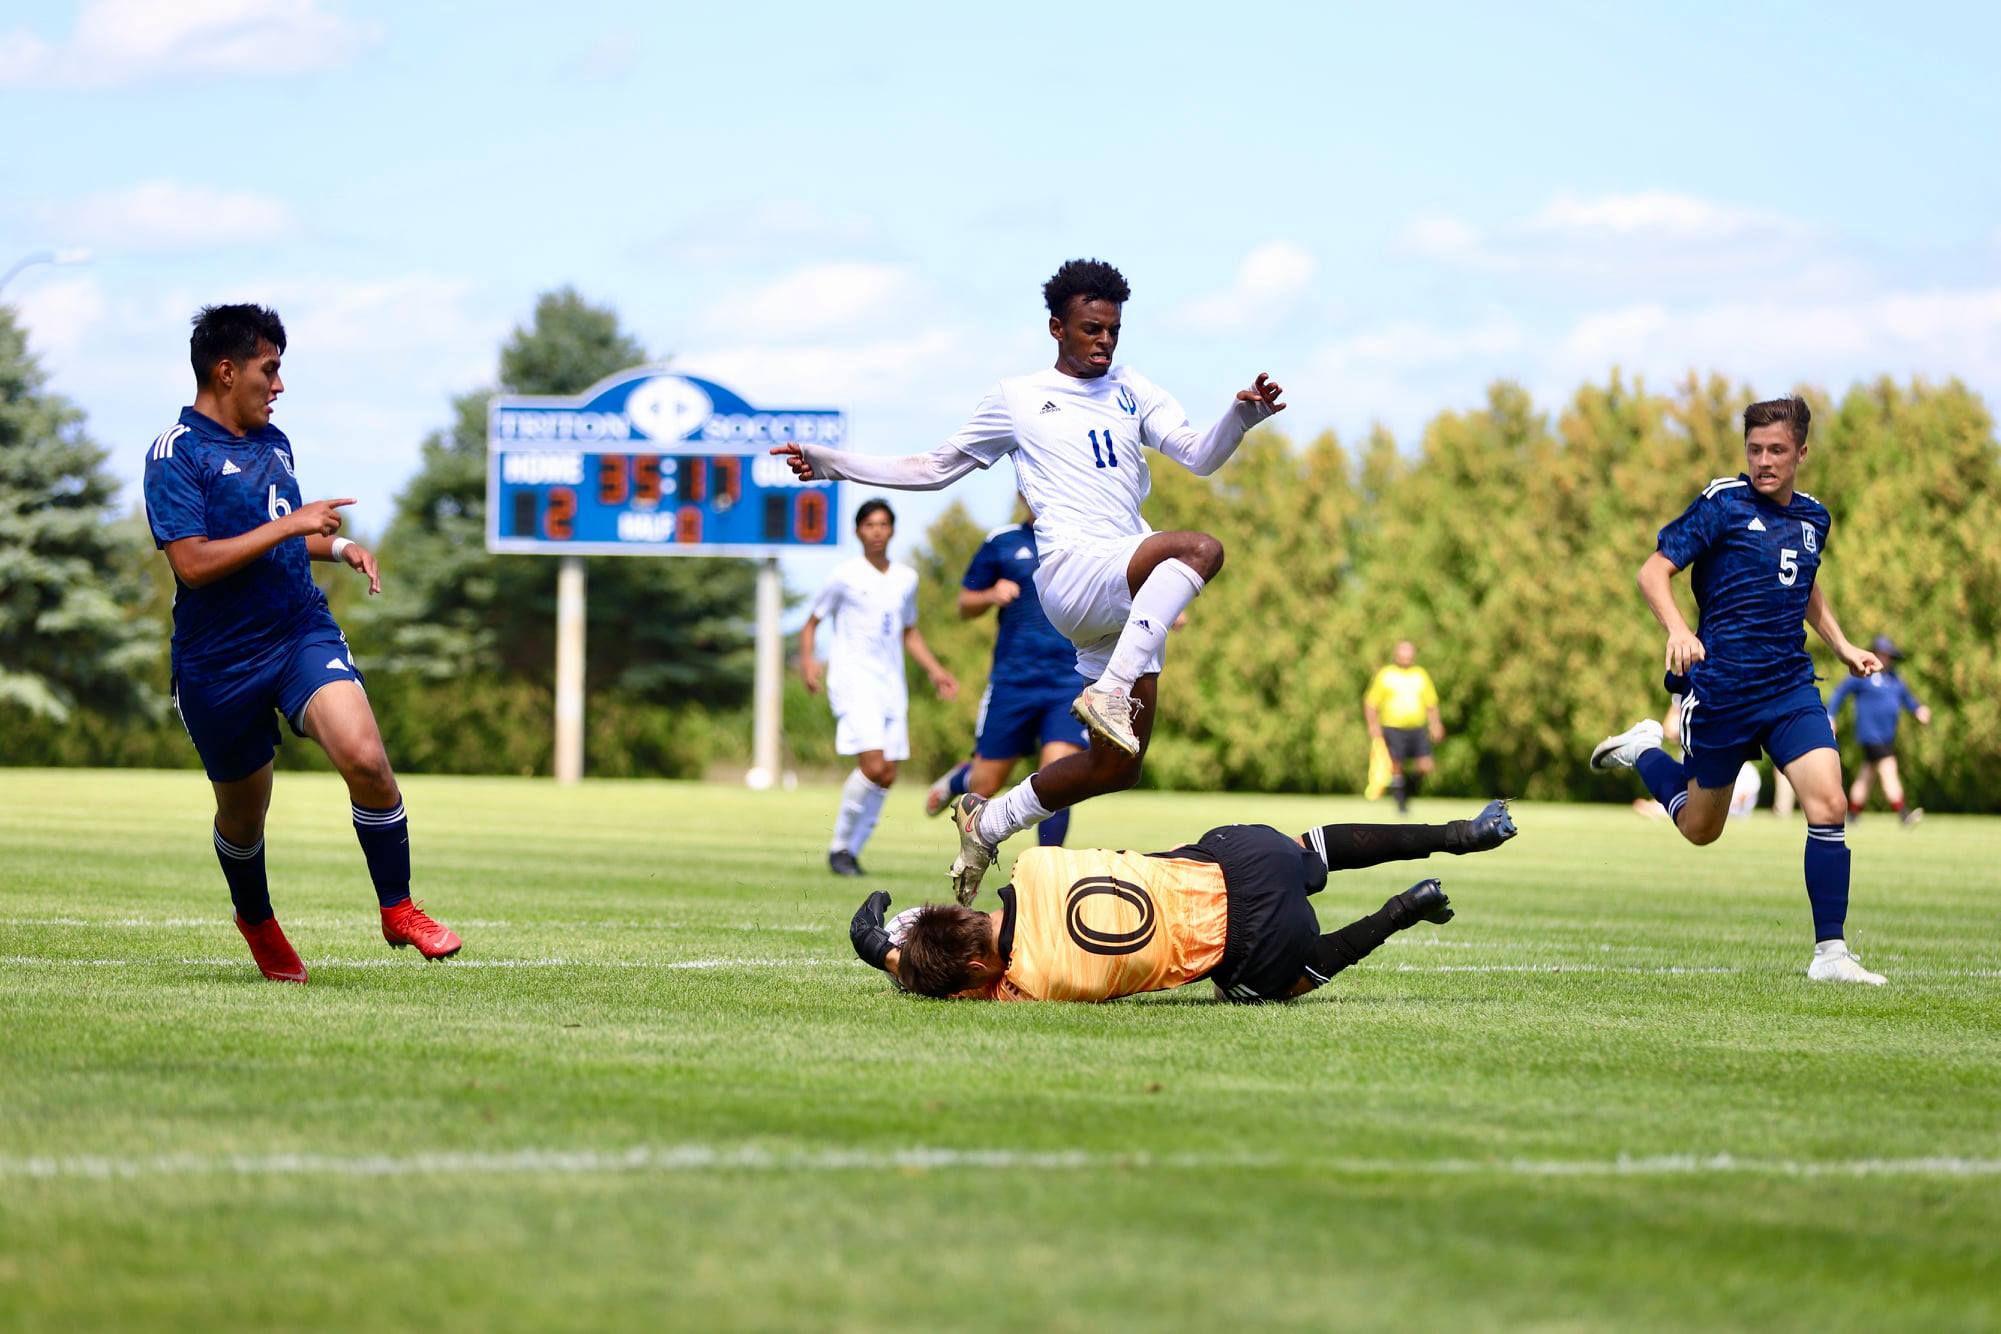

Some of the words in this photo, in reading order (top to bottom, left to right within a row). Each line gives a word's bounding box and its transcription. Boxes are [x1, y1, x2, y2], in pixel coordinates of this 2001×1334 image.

[497, 410, 630, 441] TRITON
[702, 413, 841, 443] SOCCER
[1088, 429, 1118, 468] 11
[502, 452, 584, 484] HOME
[268, 484, 292, 521] 6
[544, 486, 577, 540] 2
[794, 489, 828, 543] 0
[1778, 548, 1798, 586] 5
[1066, 876, 1156, 955] 0
